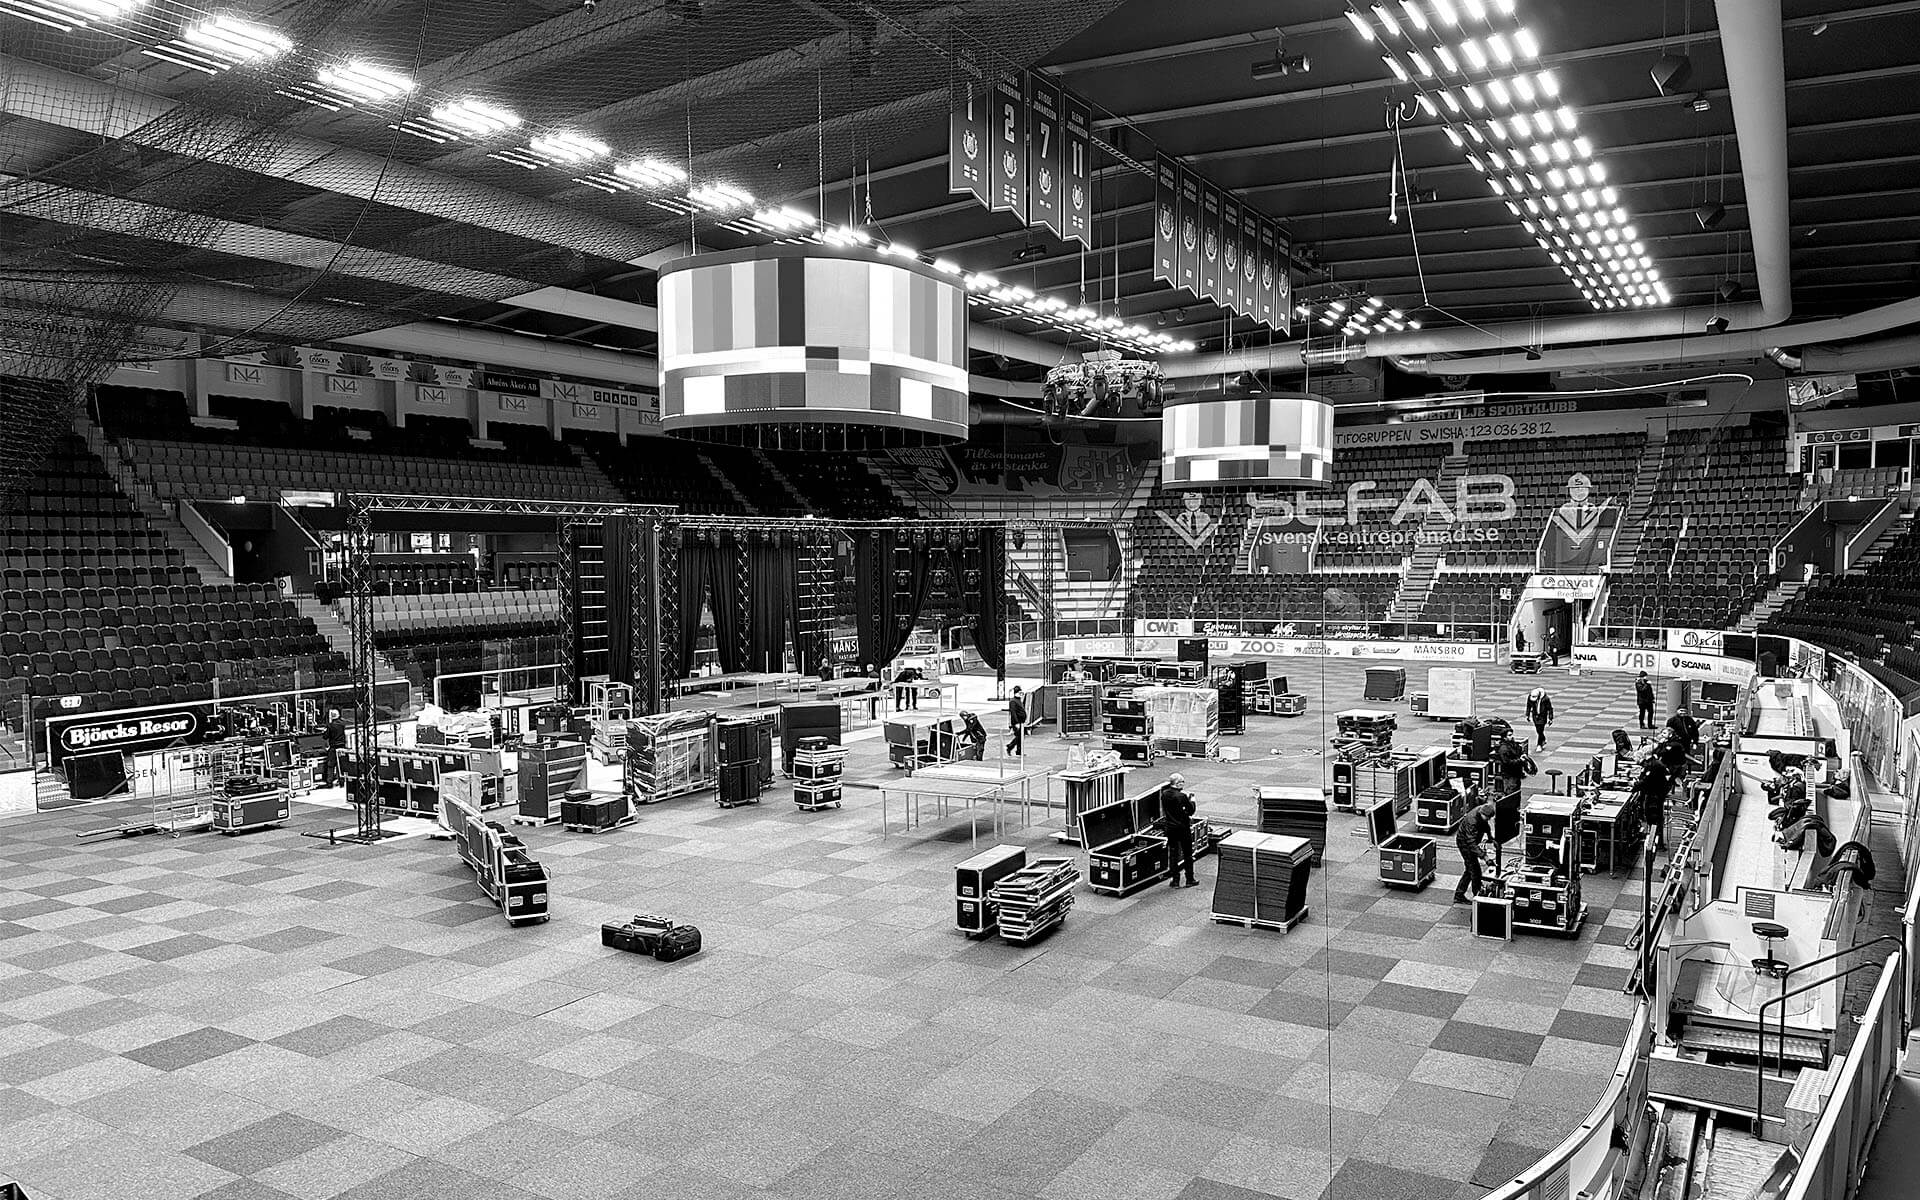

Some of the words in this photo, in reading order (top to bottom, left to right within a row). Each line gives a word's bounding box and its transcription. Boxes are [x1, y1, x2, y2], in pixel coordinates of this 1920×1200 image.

[1004, 103, 1015, 144] 2
[1040, 121, 1051, 159] 7
[1071, 140, 1084, 178] 11
[233, 366, 261, 383] N4
[332, 378, 358, 394] N4
[553, 383, 579, 401] N4
[422, 387, 447, 403] N4
[505, 397, 527, 411] N4
[578, 405, 597, 417] N4
[1488, 400, 1578, 417] SPORTKLUBB
[1335, 429, 1412, 445] TIFOGRUPPEN
[1493, 423, 1518, 436] 036
[1519, 422, 1537, 435] 38
[1262, 526, 1500, 546] svensk-entreprenad.se
[1240, 640, 1276, 653] ZOO
[1413, 644, 1465, 655] MÅNSBRO
[1681, 660, 1712, 671] SCANIA
[70, 723, 138, 746] Björcks
[139, 719, 189, 736] Resor
